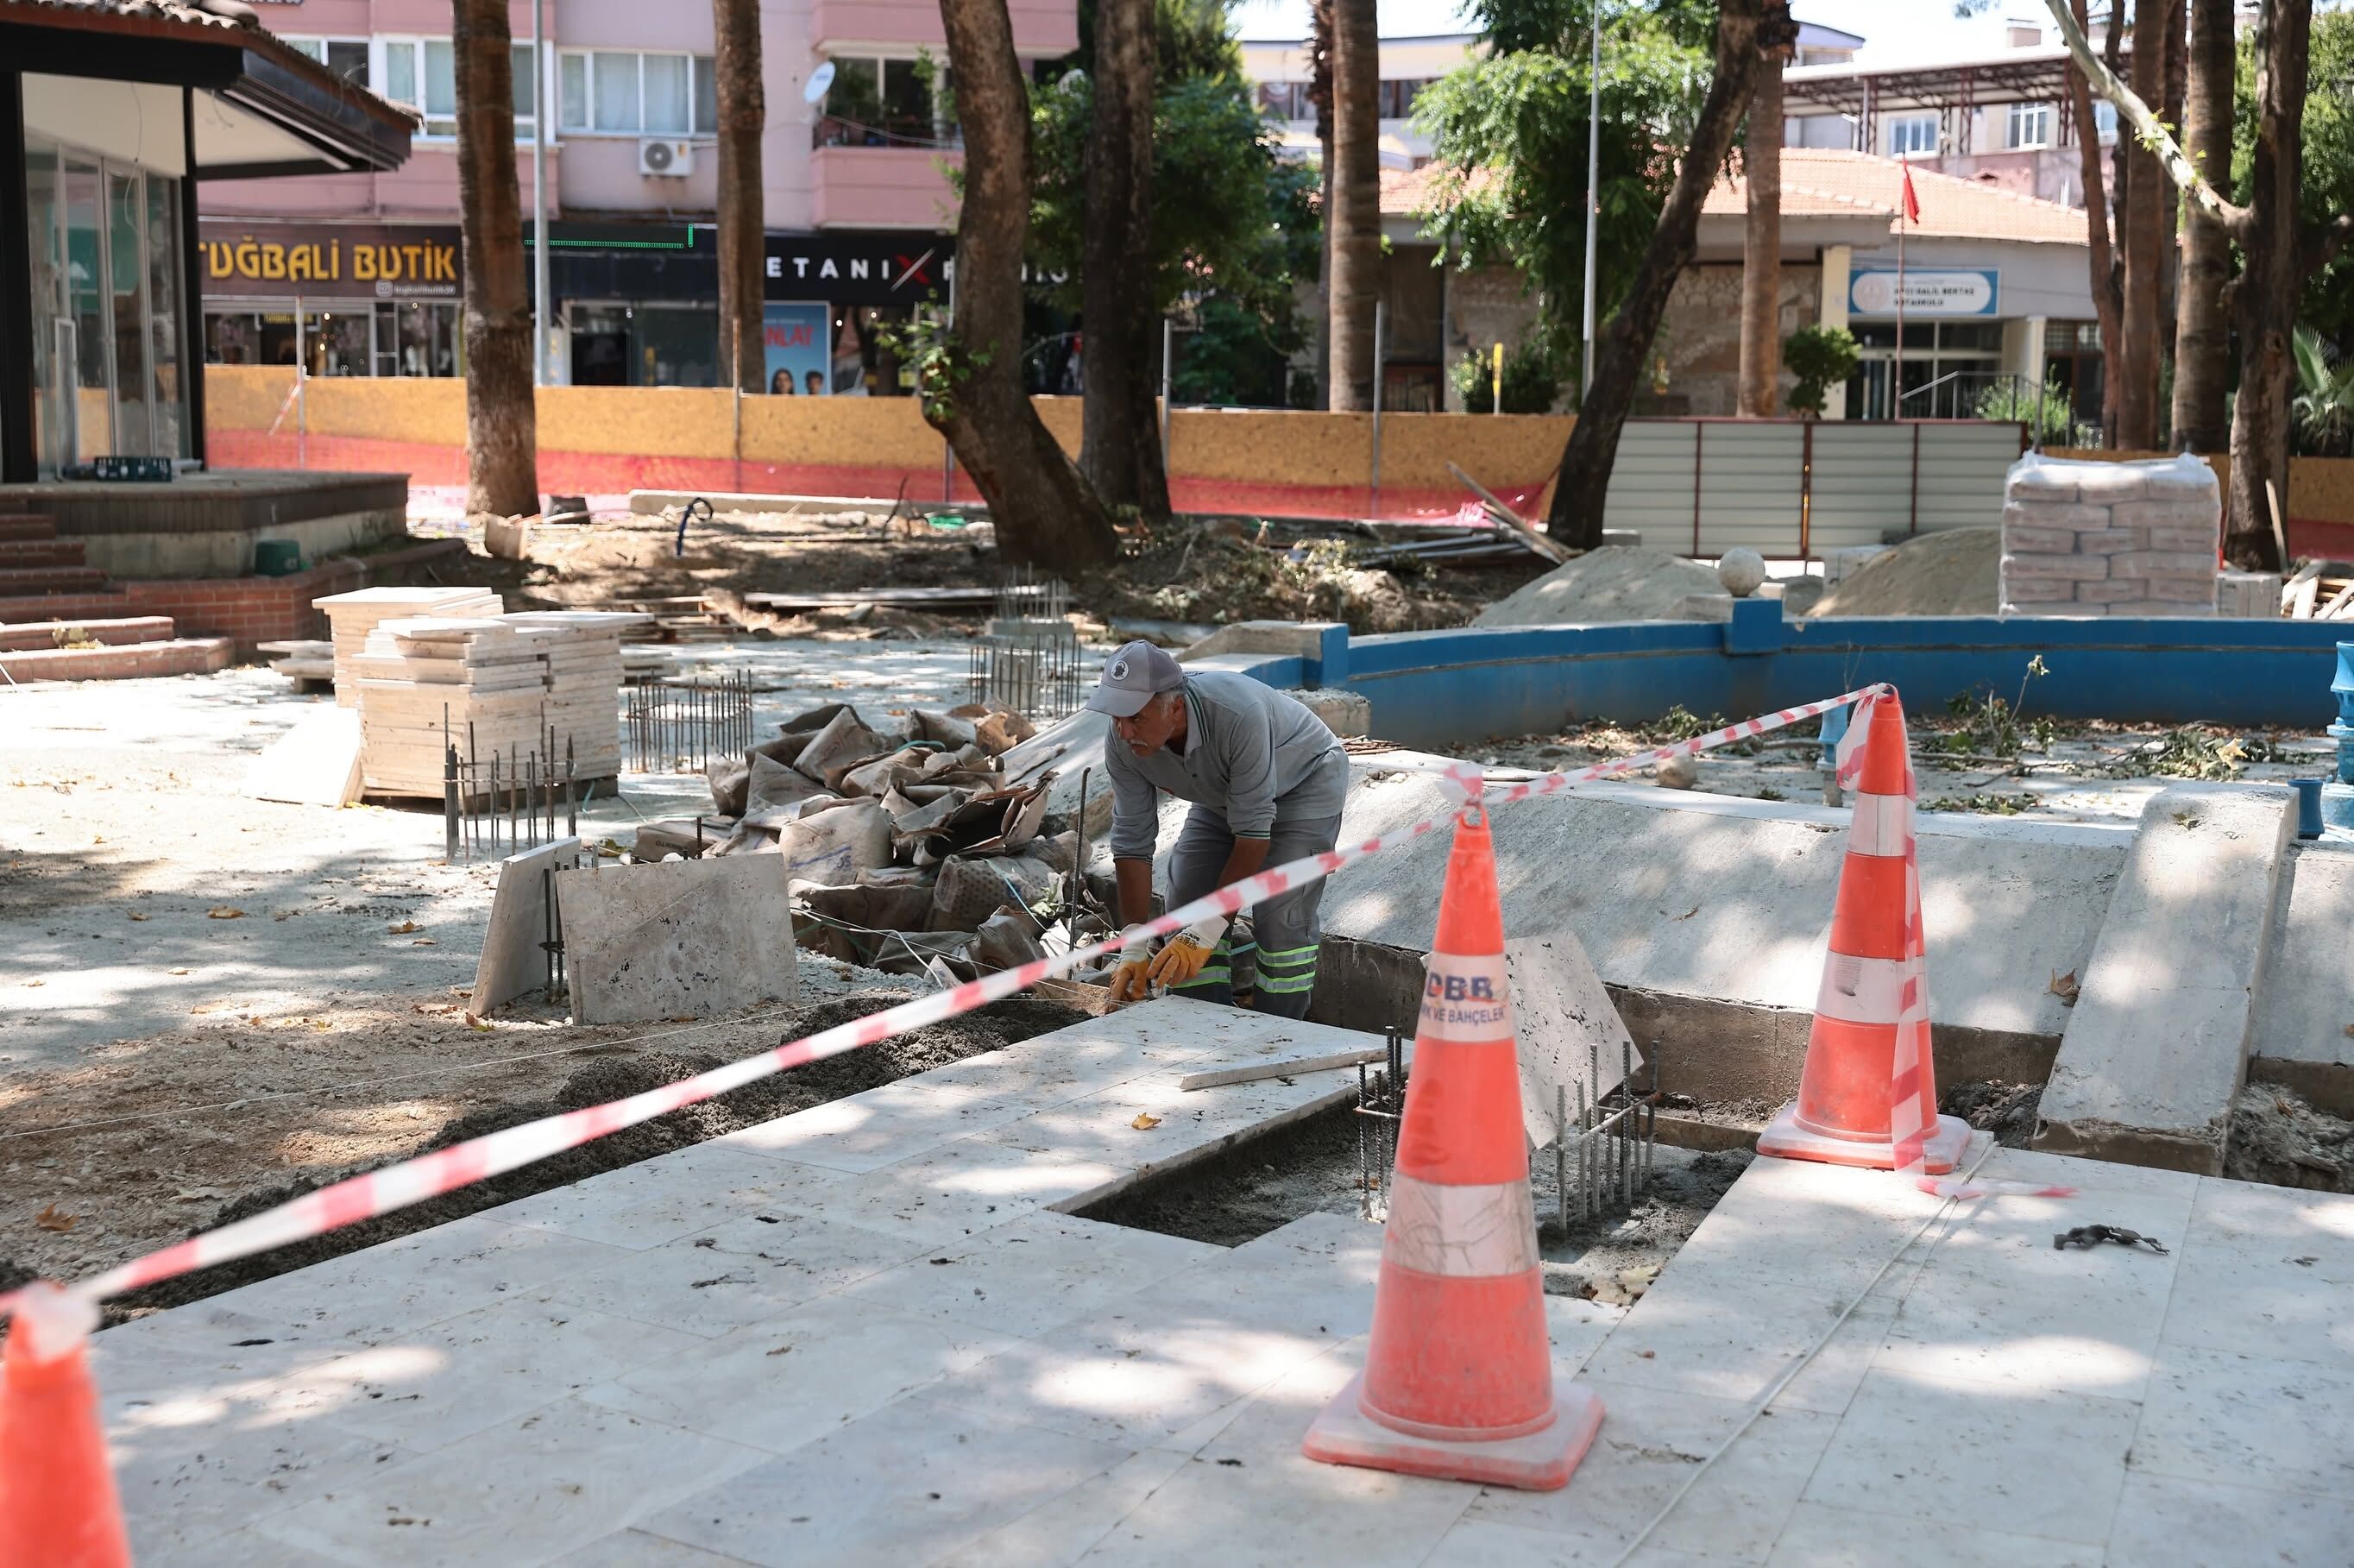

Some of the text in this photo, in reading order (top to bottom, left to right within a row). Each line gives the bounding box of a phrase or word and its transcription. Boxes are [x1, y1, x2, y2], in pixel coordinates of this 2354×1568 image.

[198, 234, 456, 282] UĞBALİ BUTİK
[765, 247, 937, 292] ETANIX
[1433, 1007, 1445, 1023] VE
[1448, 1006, 1505, 1025] BAHÇELER
